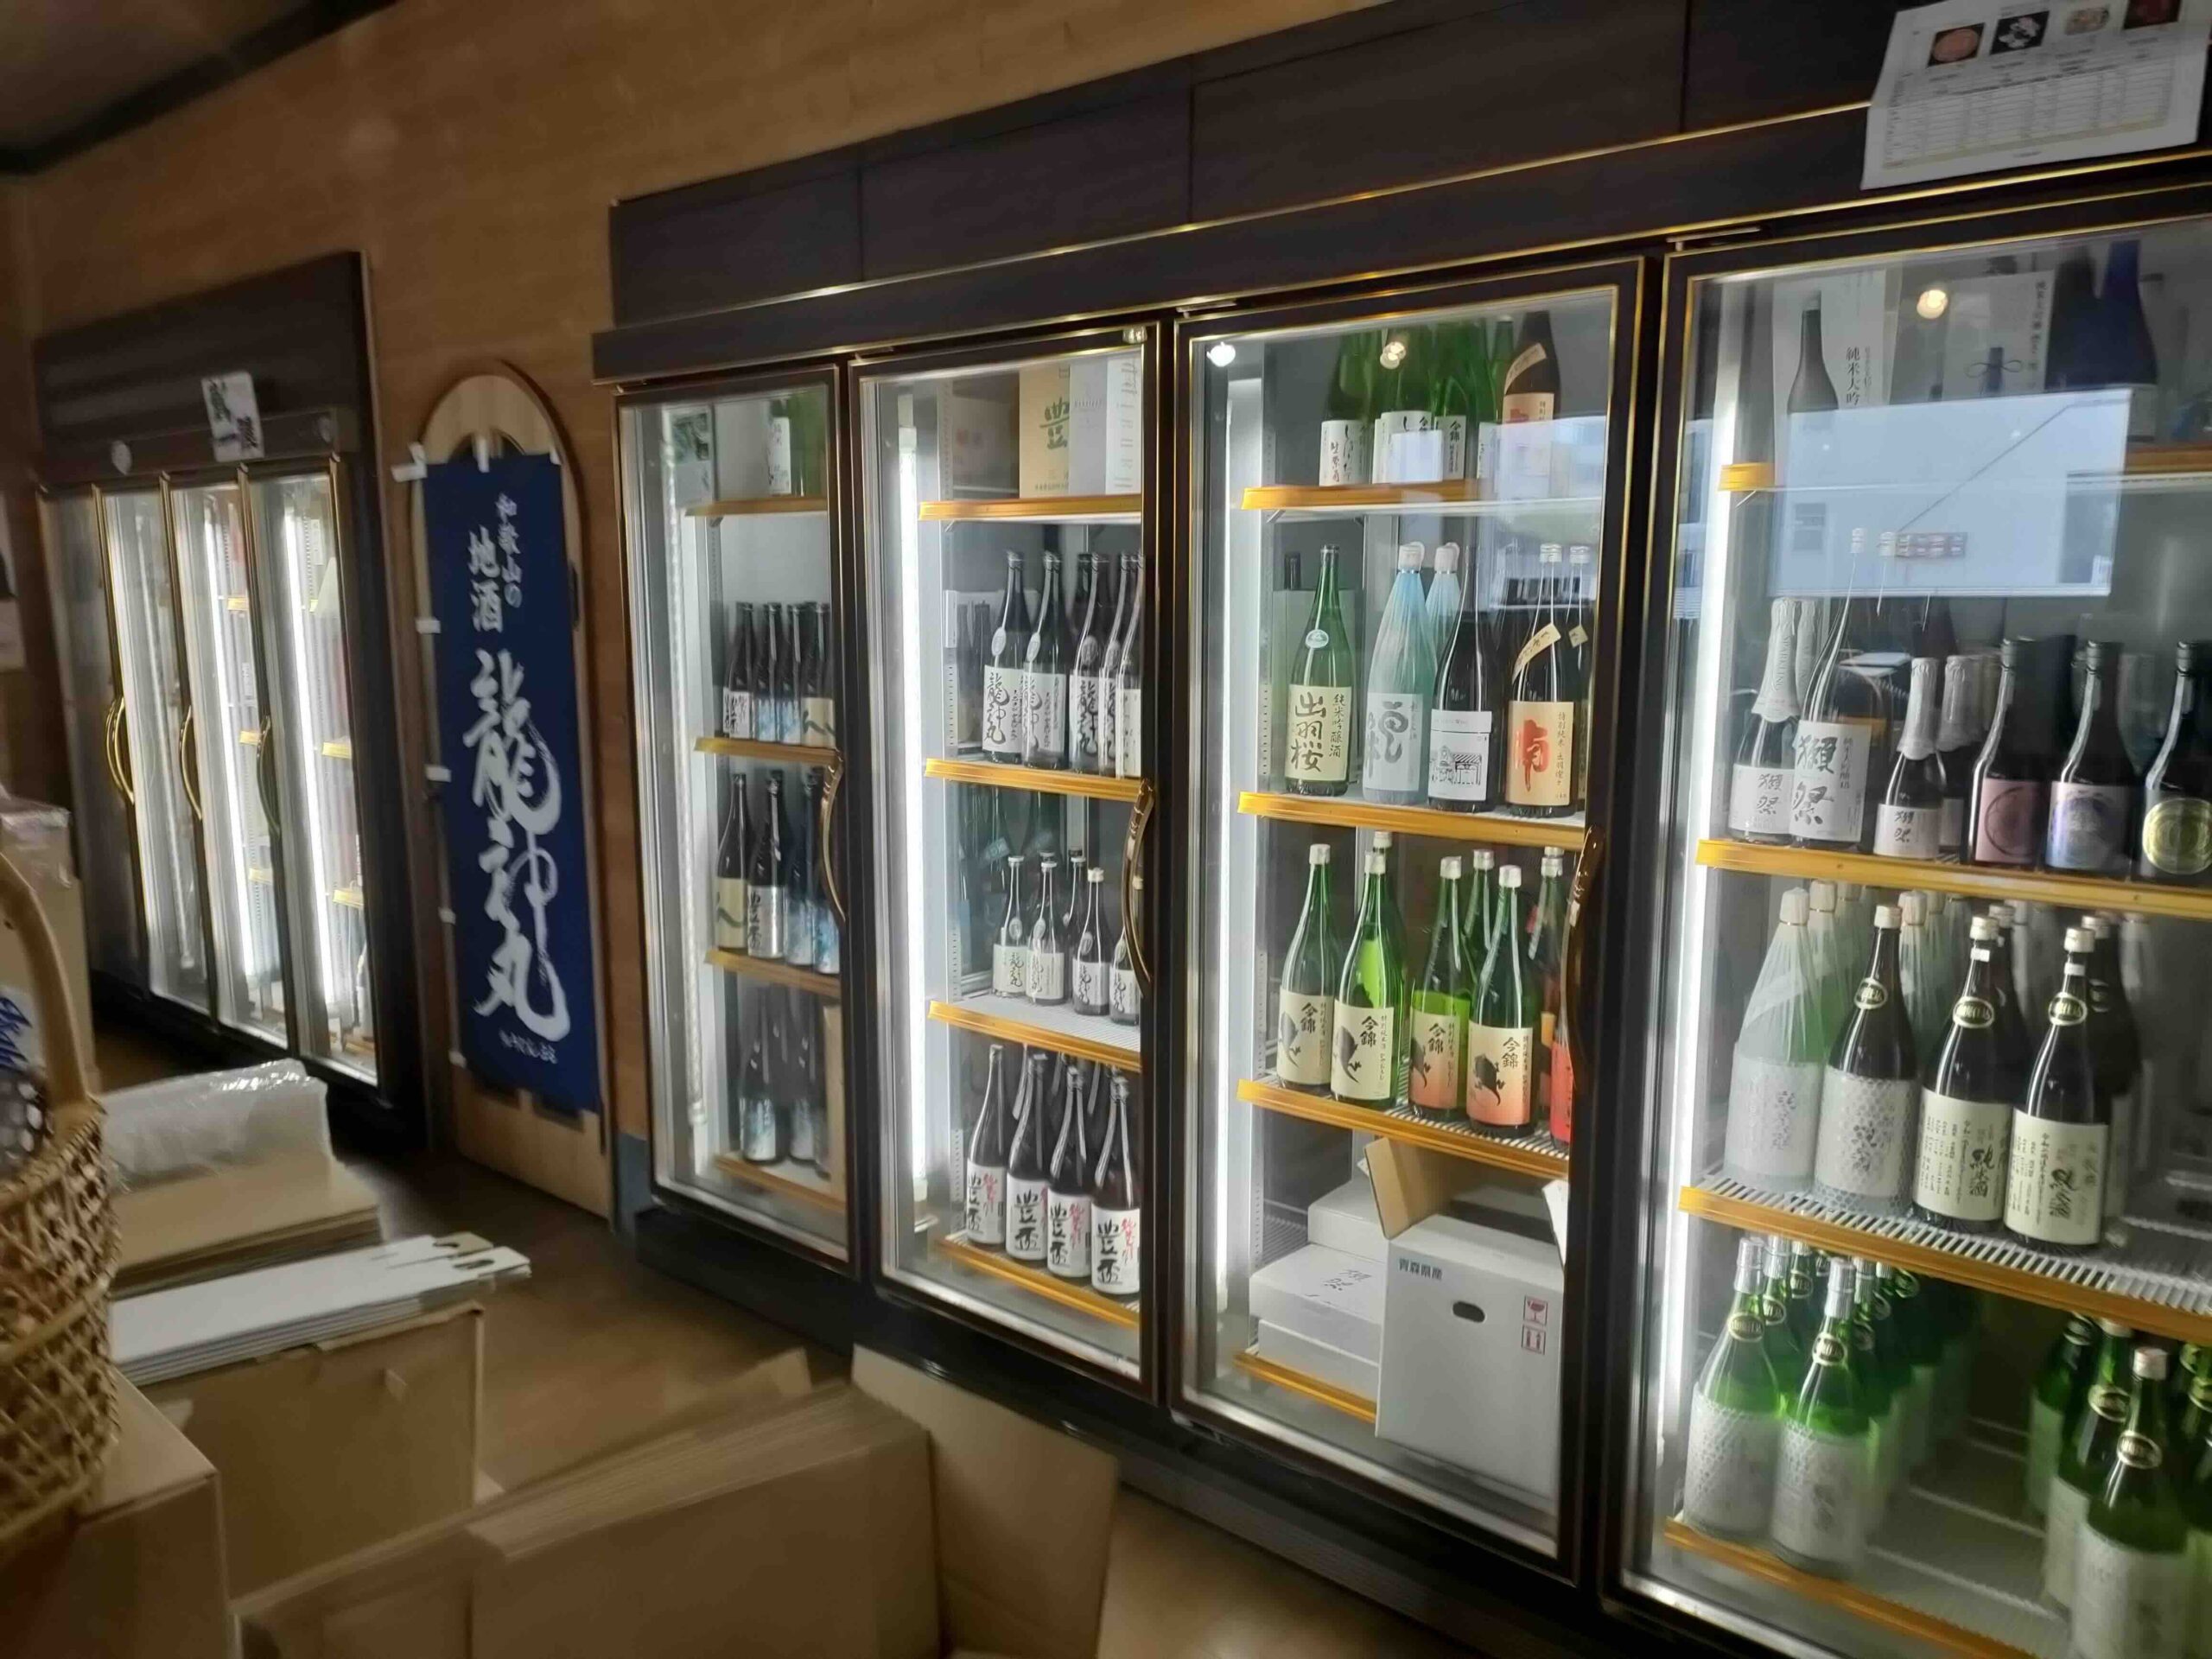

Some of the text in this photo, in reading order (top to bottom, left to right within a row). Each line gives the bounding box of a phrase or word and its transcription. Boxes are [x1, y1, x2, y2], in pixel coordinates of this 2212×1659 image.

[467, 523, 503, 632] 地酒
[1290, 691, 1326, 772] 出羽桜
[1329, 693, 1345, 759] 純米吟醸酒
[1756, 772, 1784, 816] 獺祭
[1792, 734, 1839, 826] 獺祭
[1300, 1002, 1319, 1034] 今錦
[1360, 1015, 1380, 1047] 今錦
[1427, 1022, 1446, 1055] 今錦
[1502, 1037, 1521, 1069] 今錦
